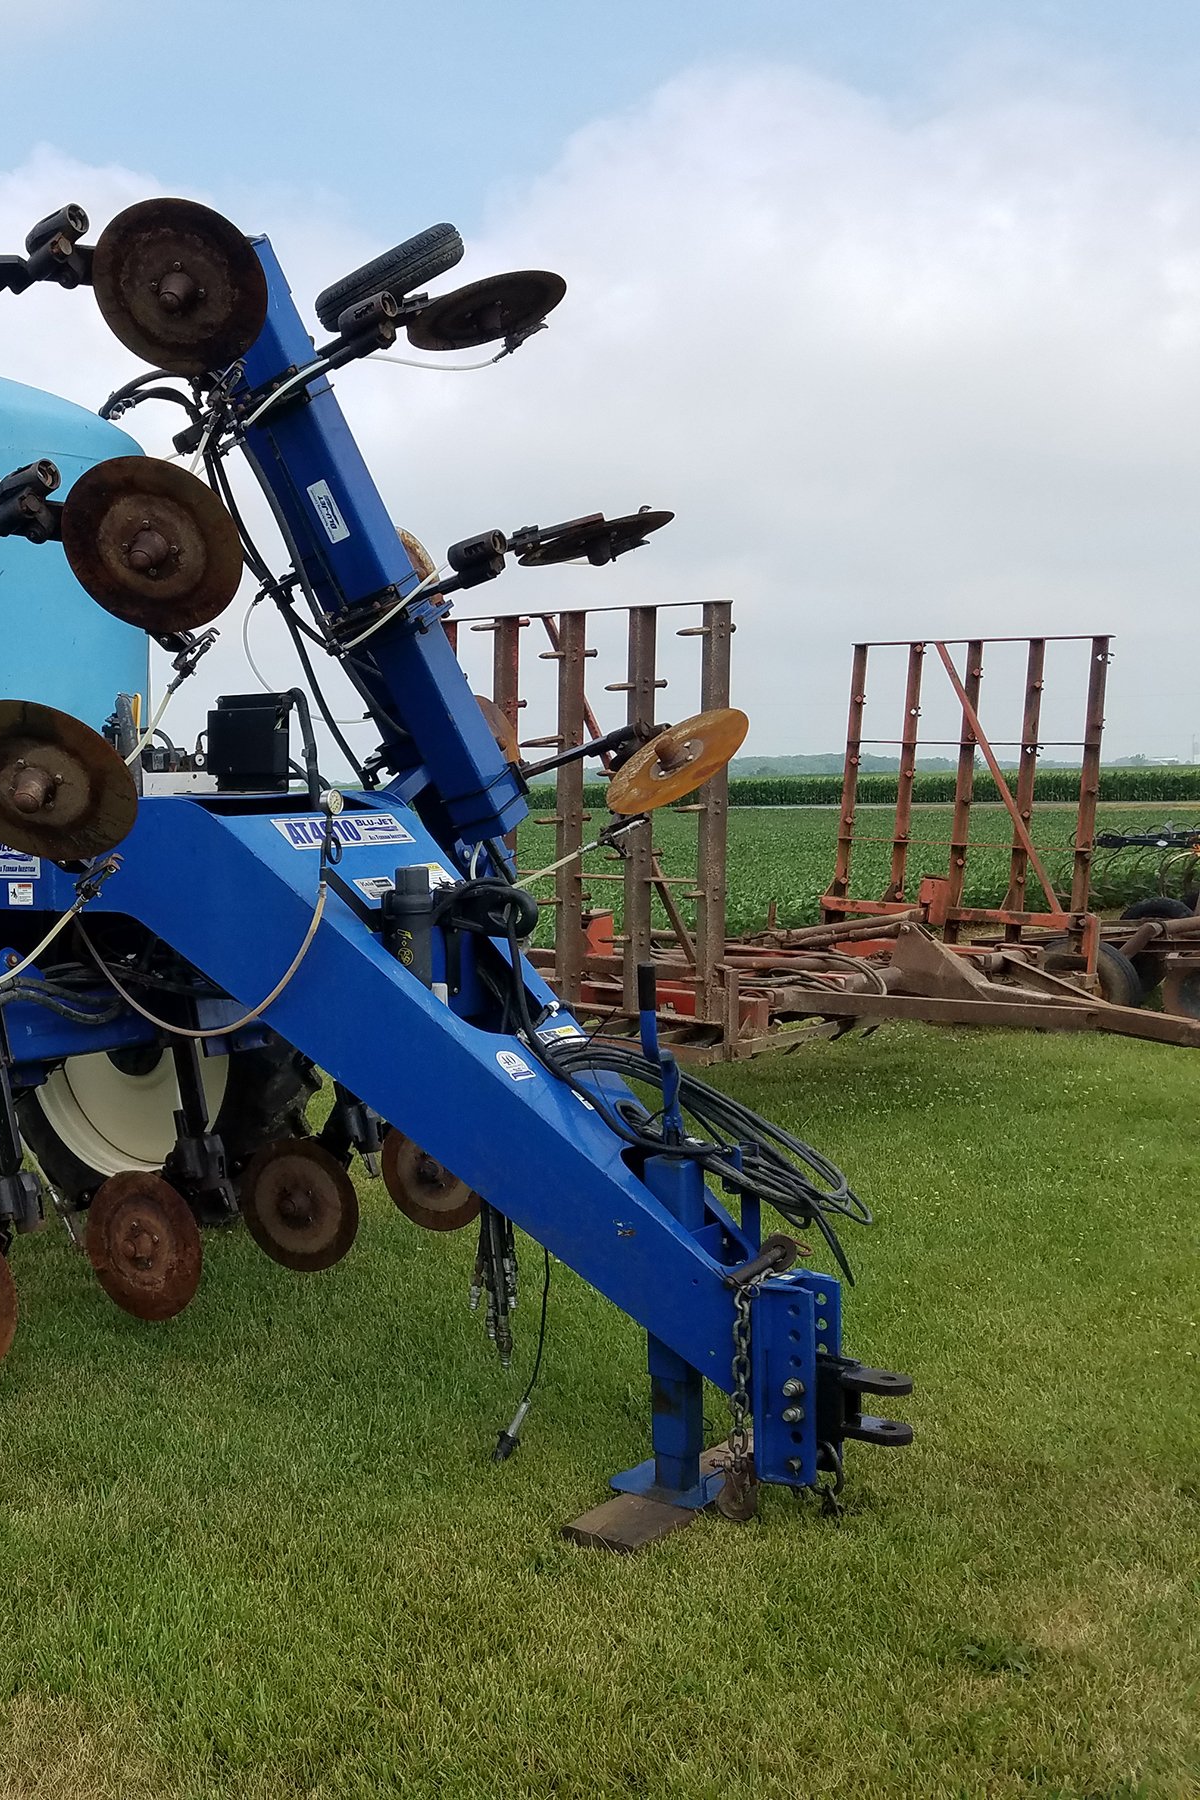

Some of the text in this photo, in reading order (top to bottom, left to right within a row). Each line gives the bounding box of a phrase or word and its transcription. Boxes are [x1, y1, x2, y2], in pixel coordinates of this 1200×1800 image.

[317, 495, 338, 530] BLU-JET
[354, 818, 393, 827] BLU-JET
[501, 1055, 517, 1067] 40
